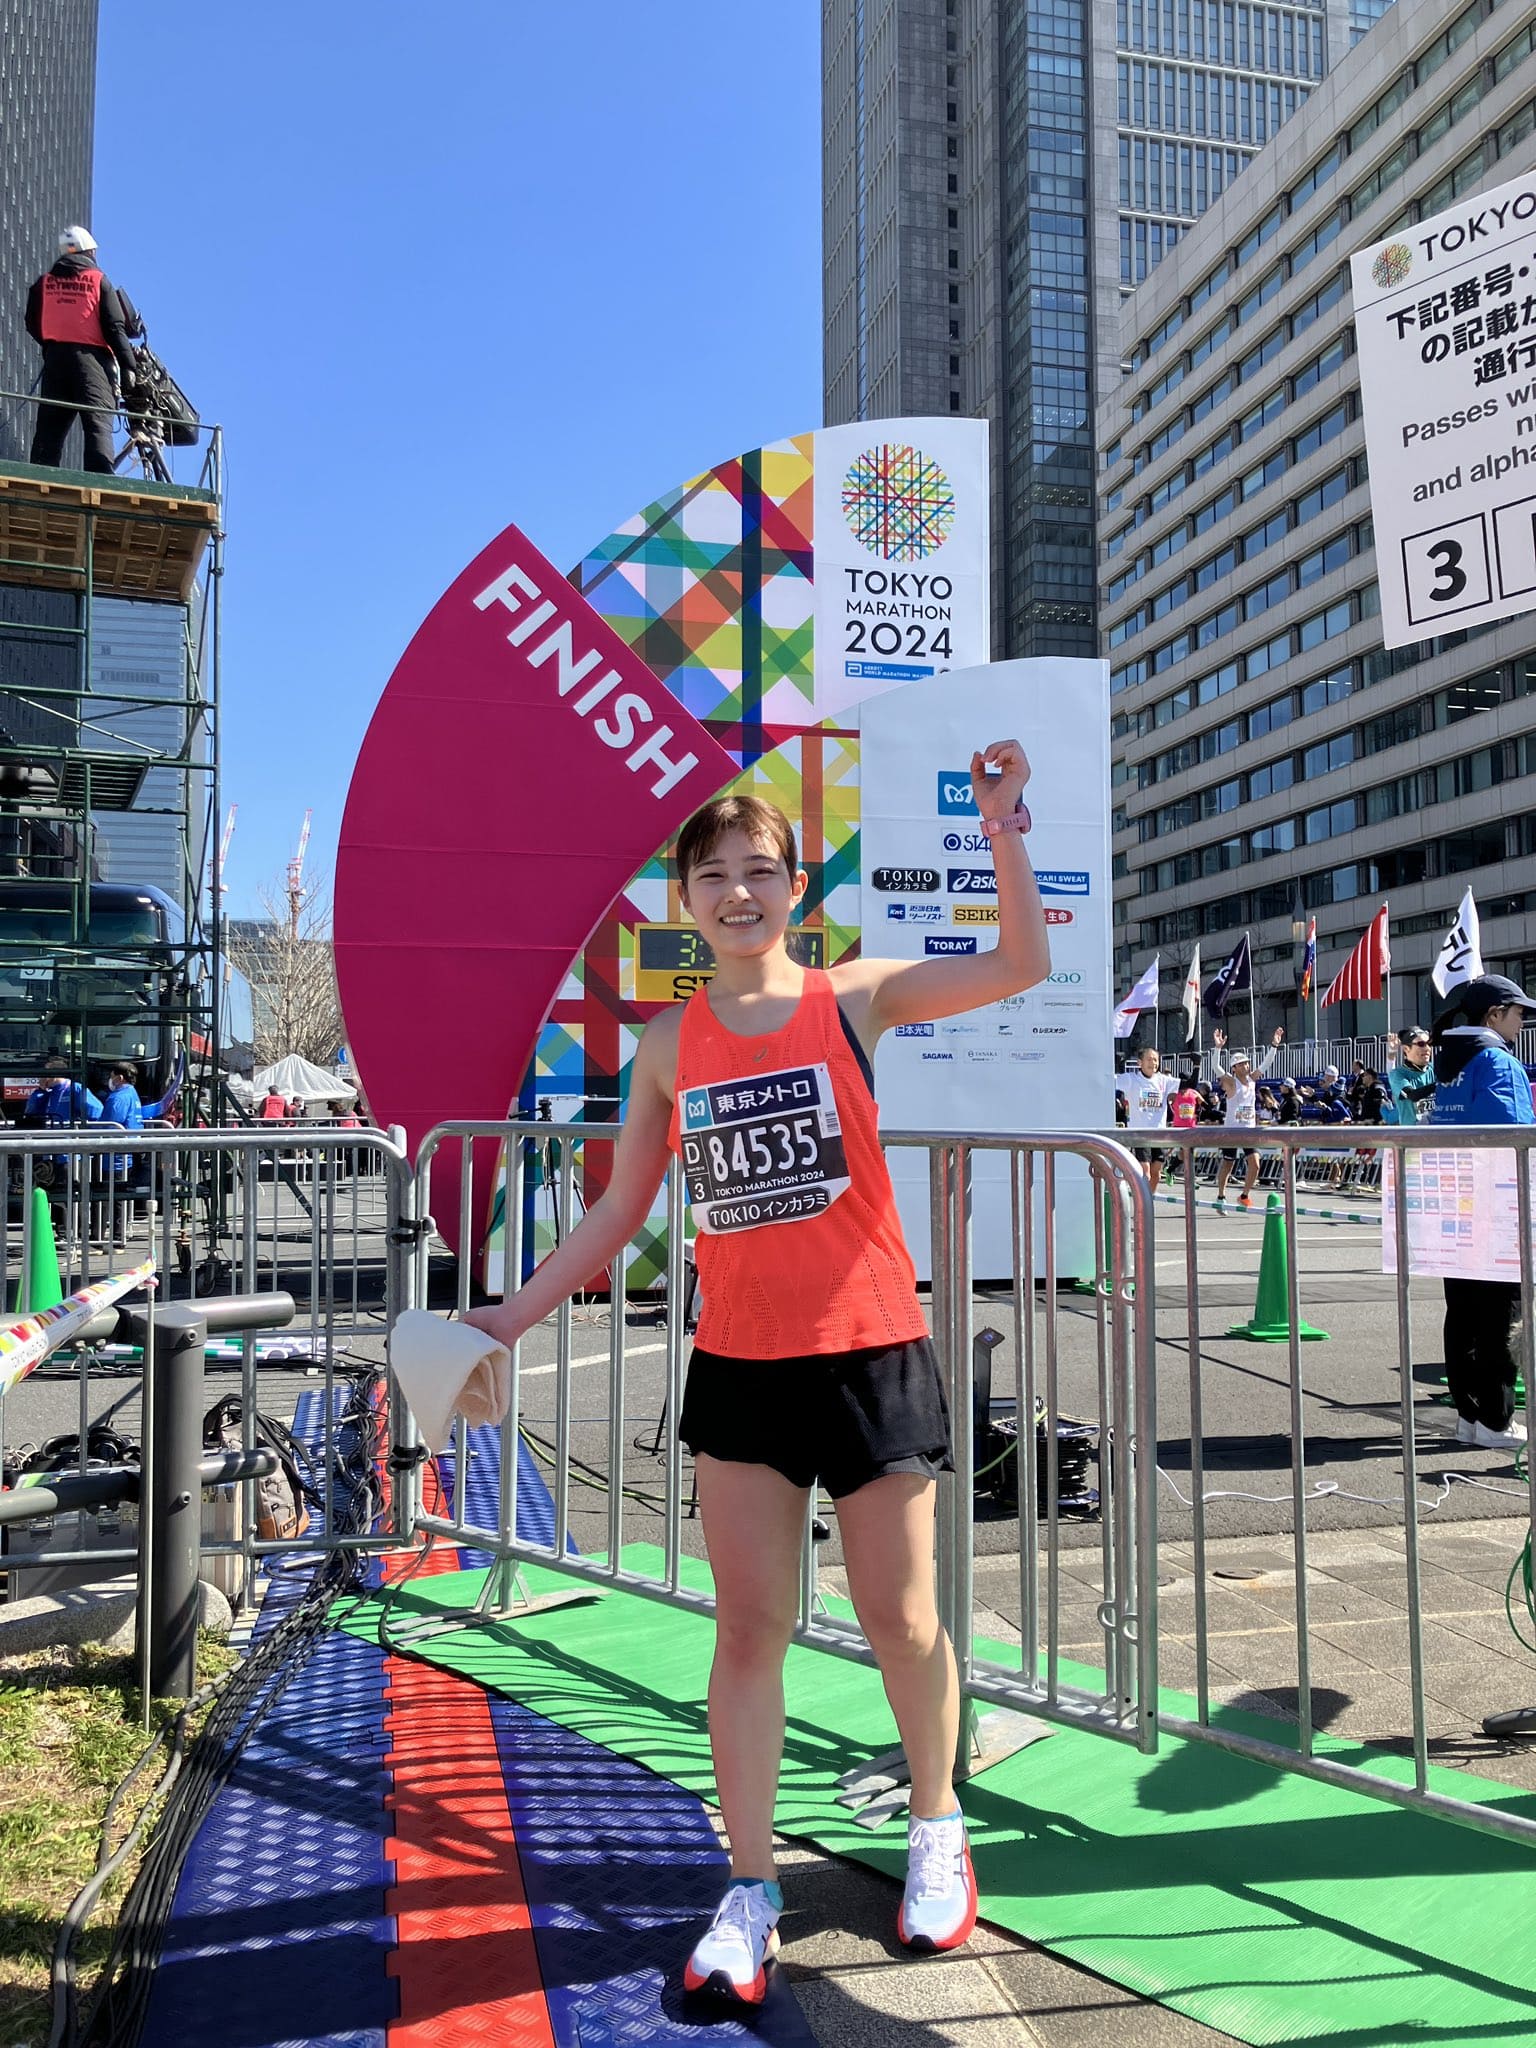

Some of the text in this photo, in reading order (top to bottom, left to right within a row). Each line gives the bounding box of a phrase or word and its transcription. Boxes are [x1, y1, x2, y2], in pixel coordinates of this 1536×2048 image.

[1419, 192, 1536, 262] TOKYO
[1402, 399, 1498, 448] Passes
[1413, 466, 1462, 502] and
[845, 568, 953, 600] TOKYO
[1426, 539, 1467, 602] 3
[846, 599, 951, 621] MARATHON
[845, 620, 953, 659] 2024
[472, 563, 700, 800] FINISH
[963, 834, 992, 852] STA
[880, 870, 933, 883] TOKIO
[885, 882, 929, 891] インカラミ
[1058, 875, 1086, 883] SWEAT
[1044, 911, 1068, 922] 生命
[715, 1080, 811, 1113] 東京メトロ
[685, 1142, 700, 1164] D
[709, 1118, 818, 1182] 84535
[694, 1183, 705, 1200] 3
[715, 1170, 825, 1198] TOKYO MARATHON 2024
[710, 1192, 828, 1227] TOKIO インカラミ
